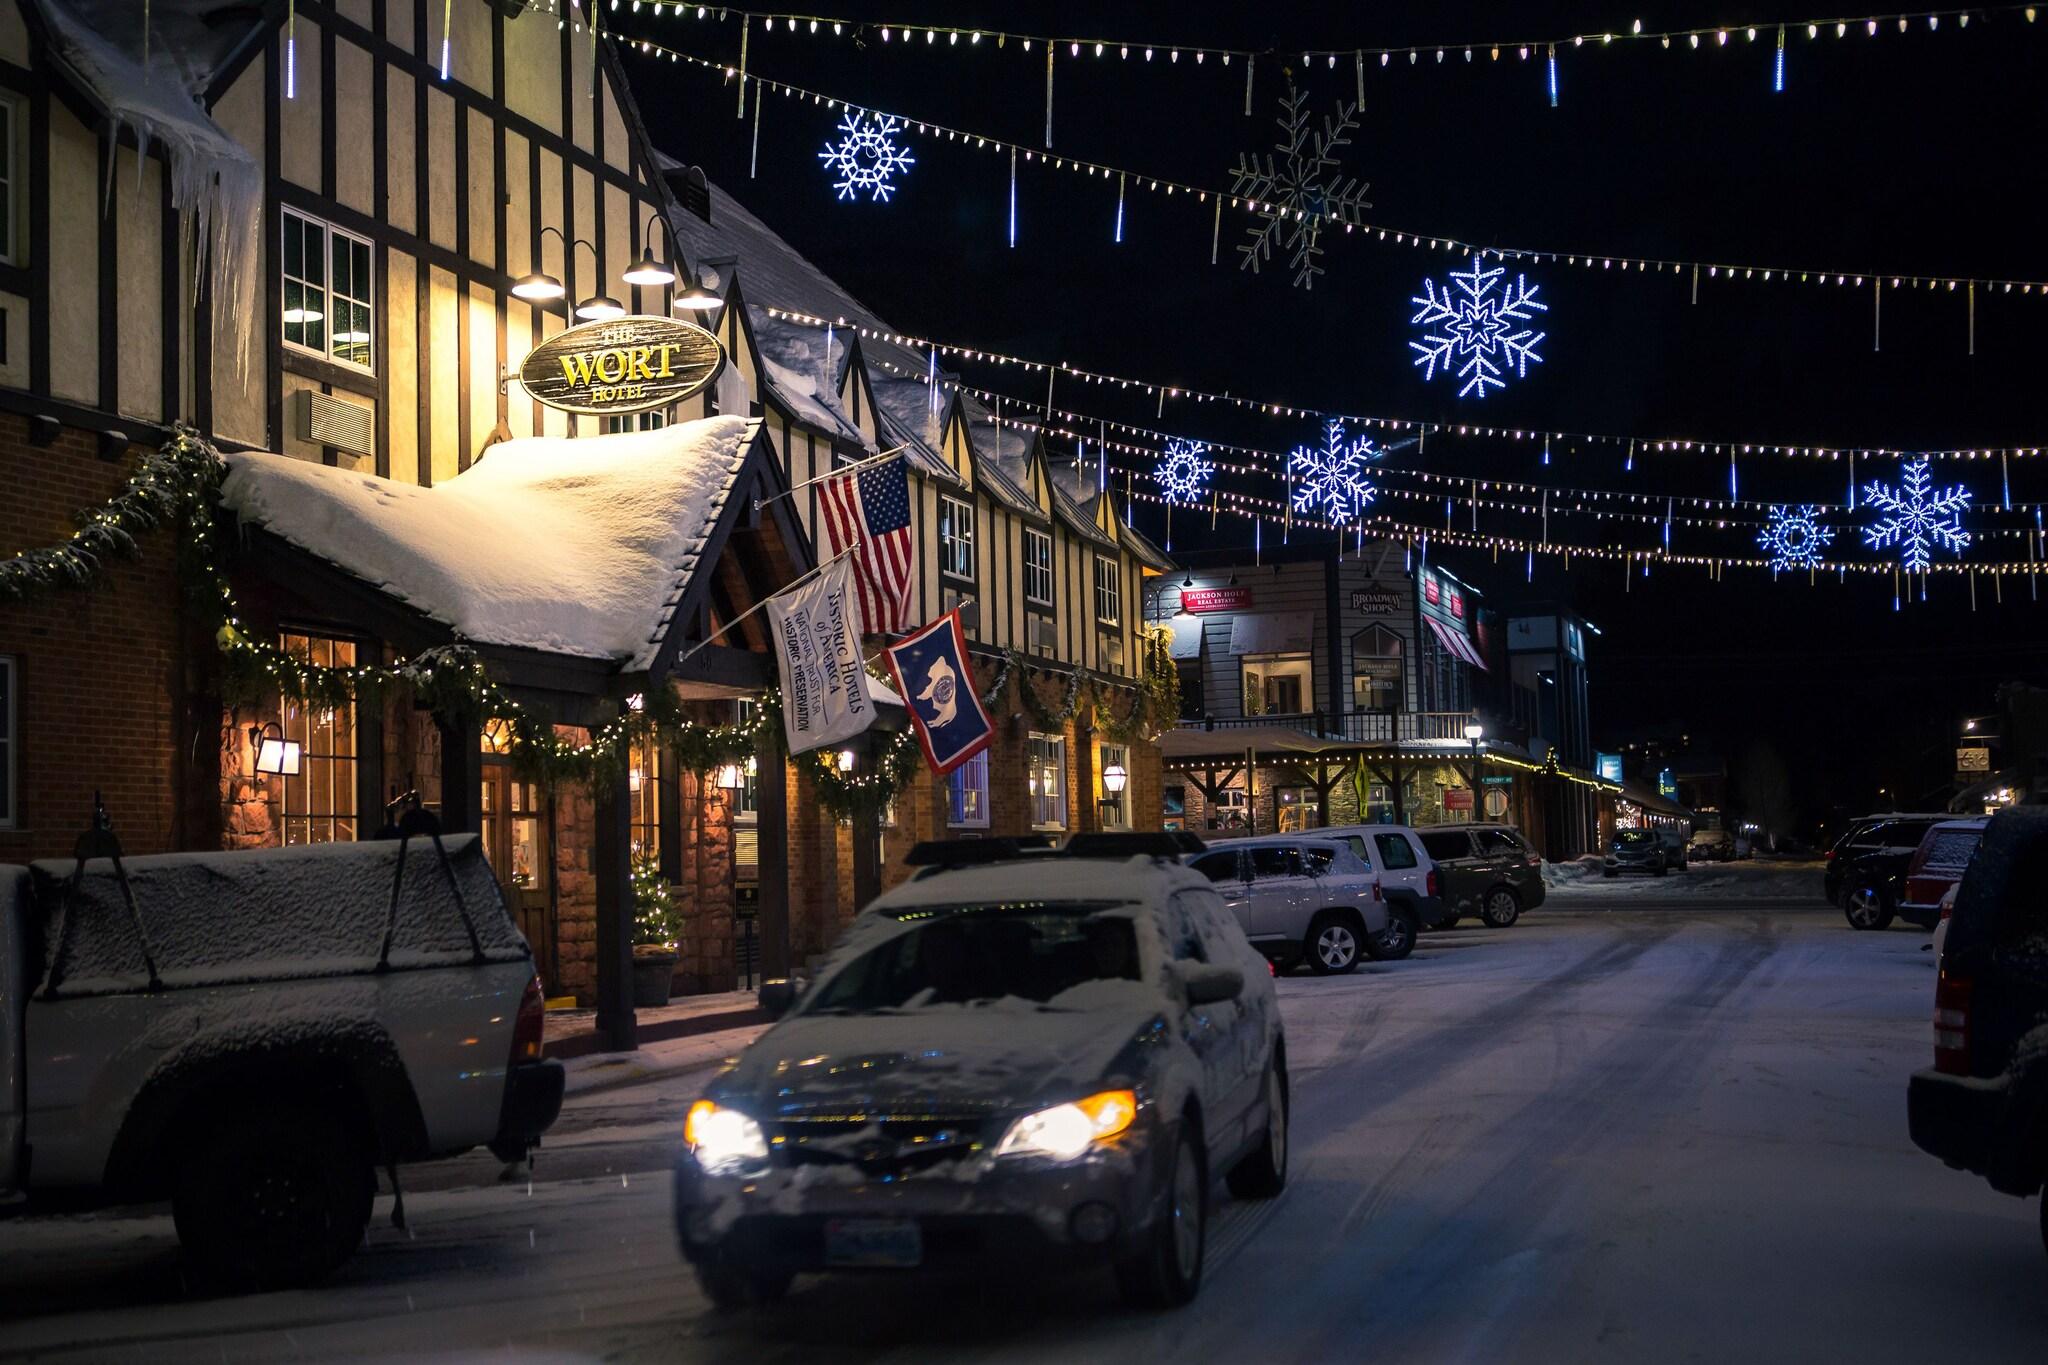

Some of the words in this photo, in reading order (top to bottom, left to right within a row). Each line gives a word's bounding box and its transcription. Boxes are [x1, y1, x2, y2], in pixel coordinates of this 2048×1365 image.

[601, 328, 635, 344] THE
[558, 343, 681, 388] WORT
[591, 385, 646, 403] HOTEL
[1187, 592, 1222, 601] JACKSON
[1352, 593, 1401, 609] BROADWAY
[1362, 603, 1393, 616] SHOPS
[794, 611, 813, 662] NATIONAL
[814, 621, 831, 633] of
[784, 616, 801, 663] HISTORIC
[794, 664, 809, 732] PRESERVATION
[805, 661, 820, 696] TRUST
[840, 660, 865, 715] HOTELS
[811, 695, 821, 716] FOR
